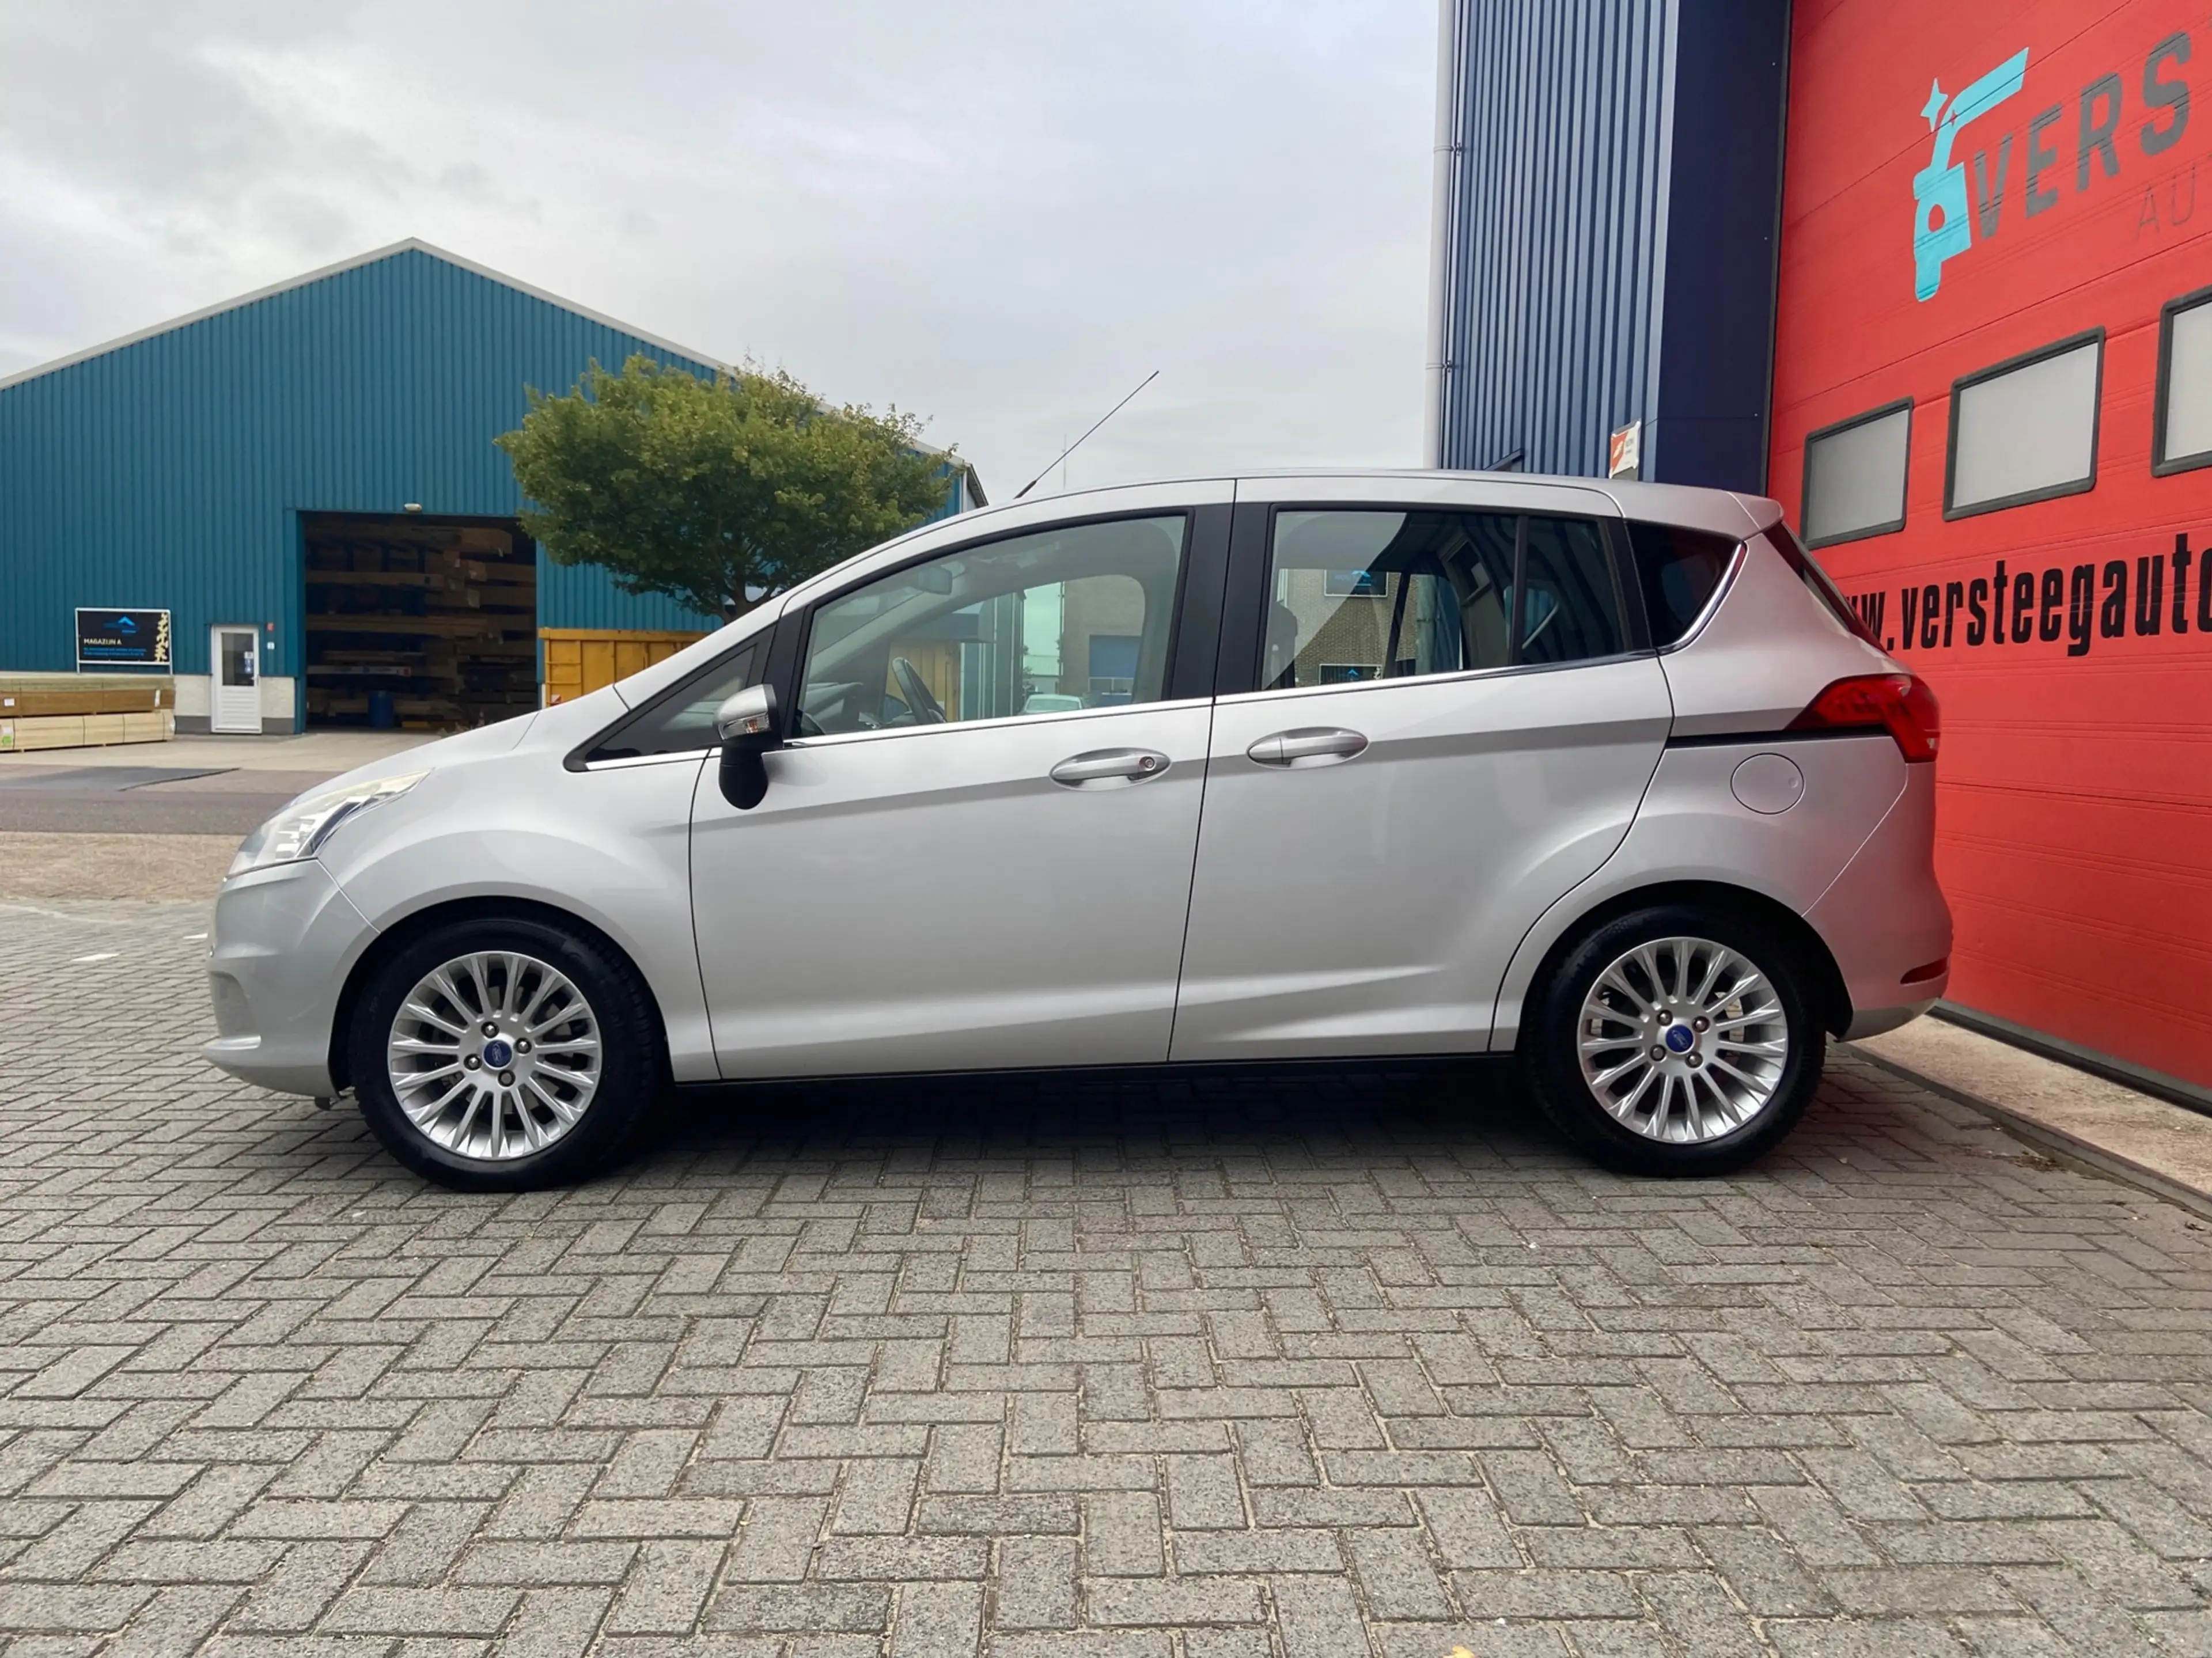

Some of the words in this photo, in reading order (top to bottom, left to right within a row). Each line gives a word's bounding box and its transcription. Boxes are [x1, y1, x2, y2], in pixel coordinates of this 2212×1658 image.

[1974, 14, 2212, 240] VERS
[2134, 154, 2212, 244] AU
[1846, 533, 2212, 657] w.versteegauto
